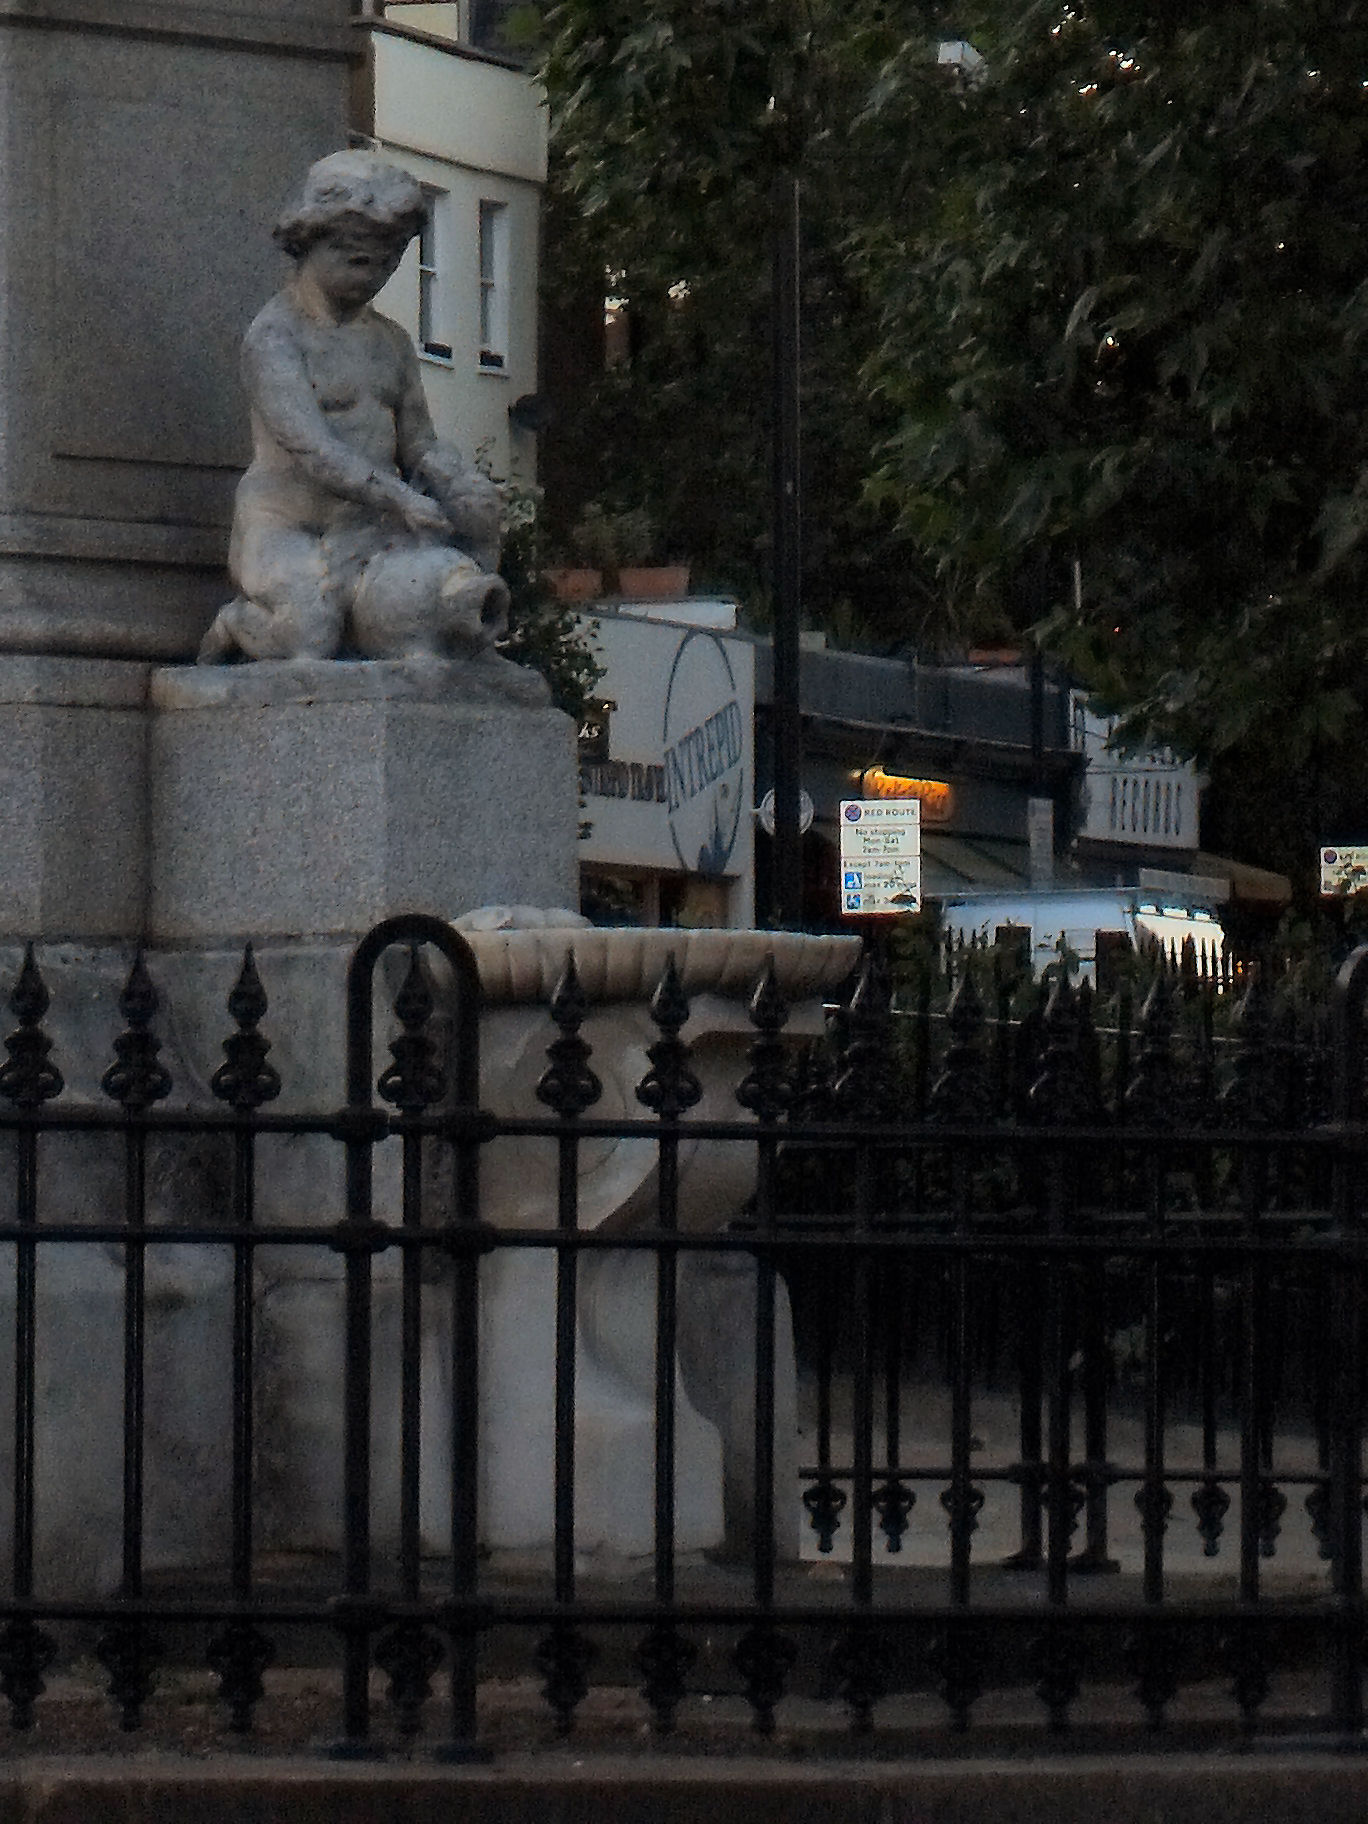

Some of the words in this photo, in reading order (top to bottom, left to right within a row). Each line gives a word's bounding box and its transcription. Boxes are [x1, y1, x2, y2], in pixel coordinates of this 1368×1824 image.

[663, 700, 743, 809] INTREPID
[864, 808, 883, 817] RED
[885, 808, 917, 817] ROUTE
